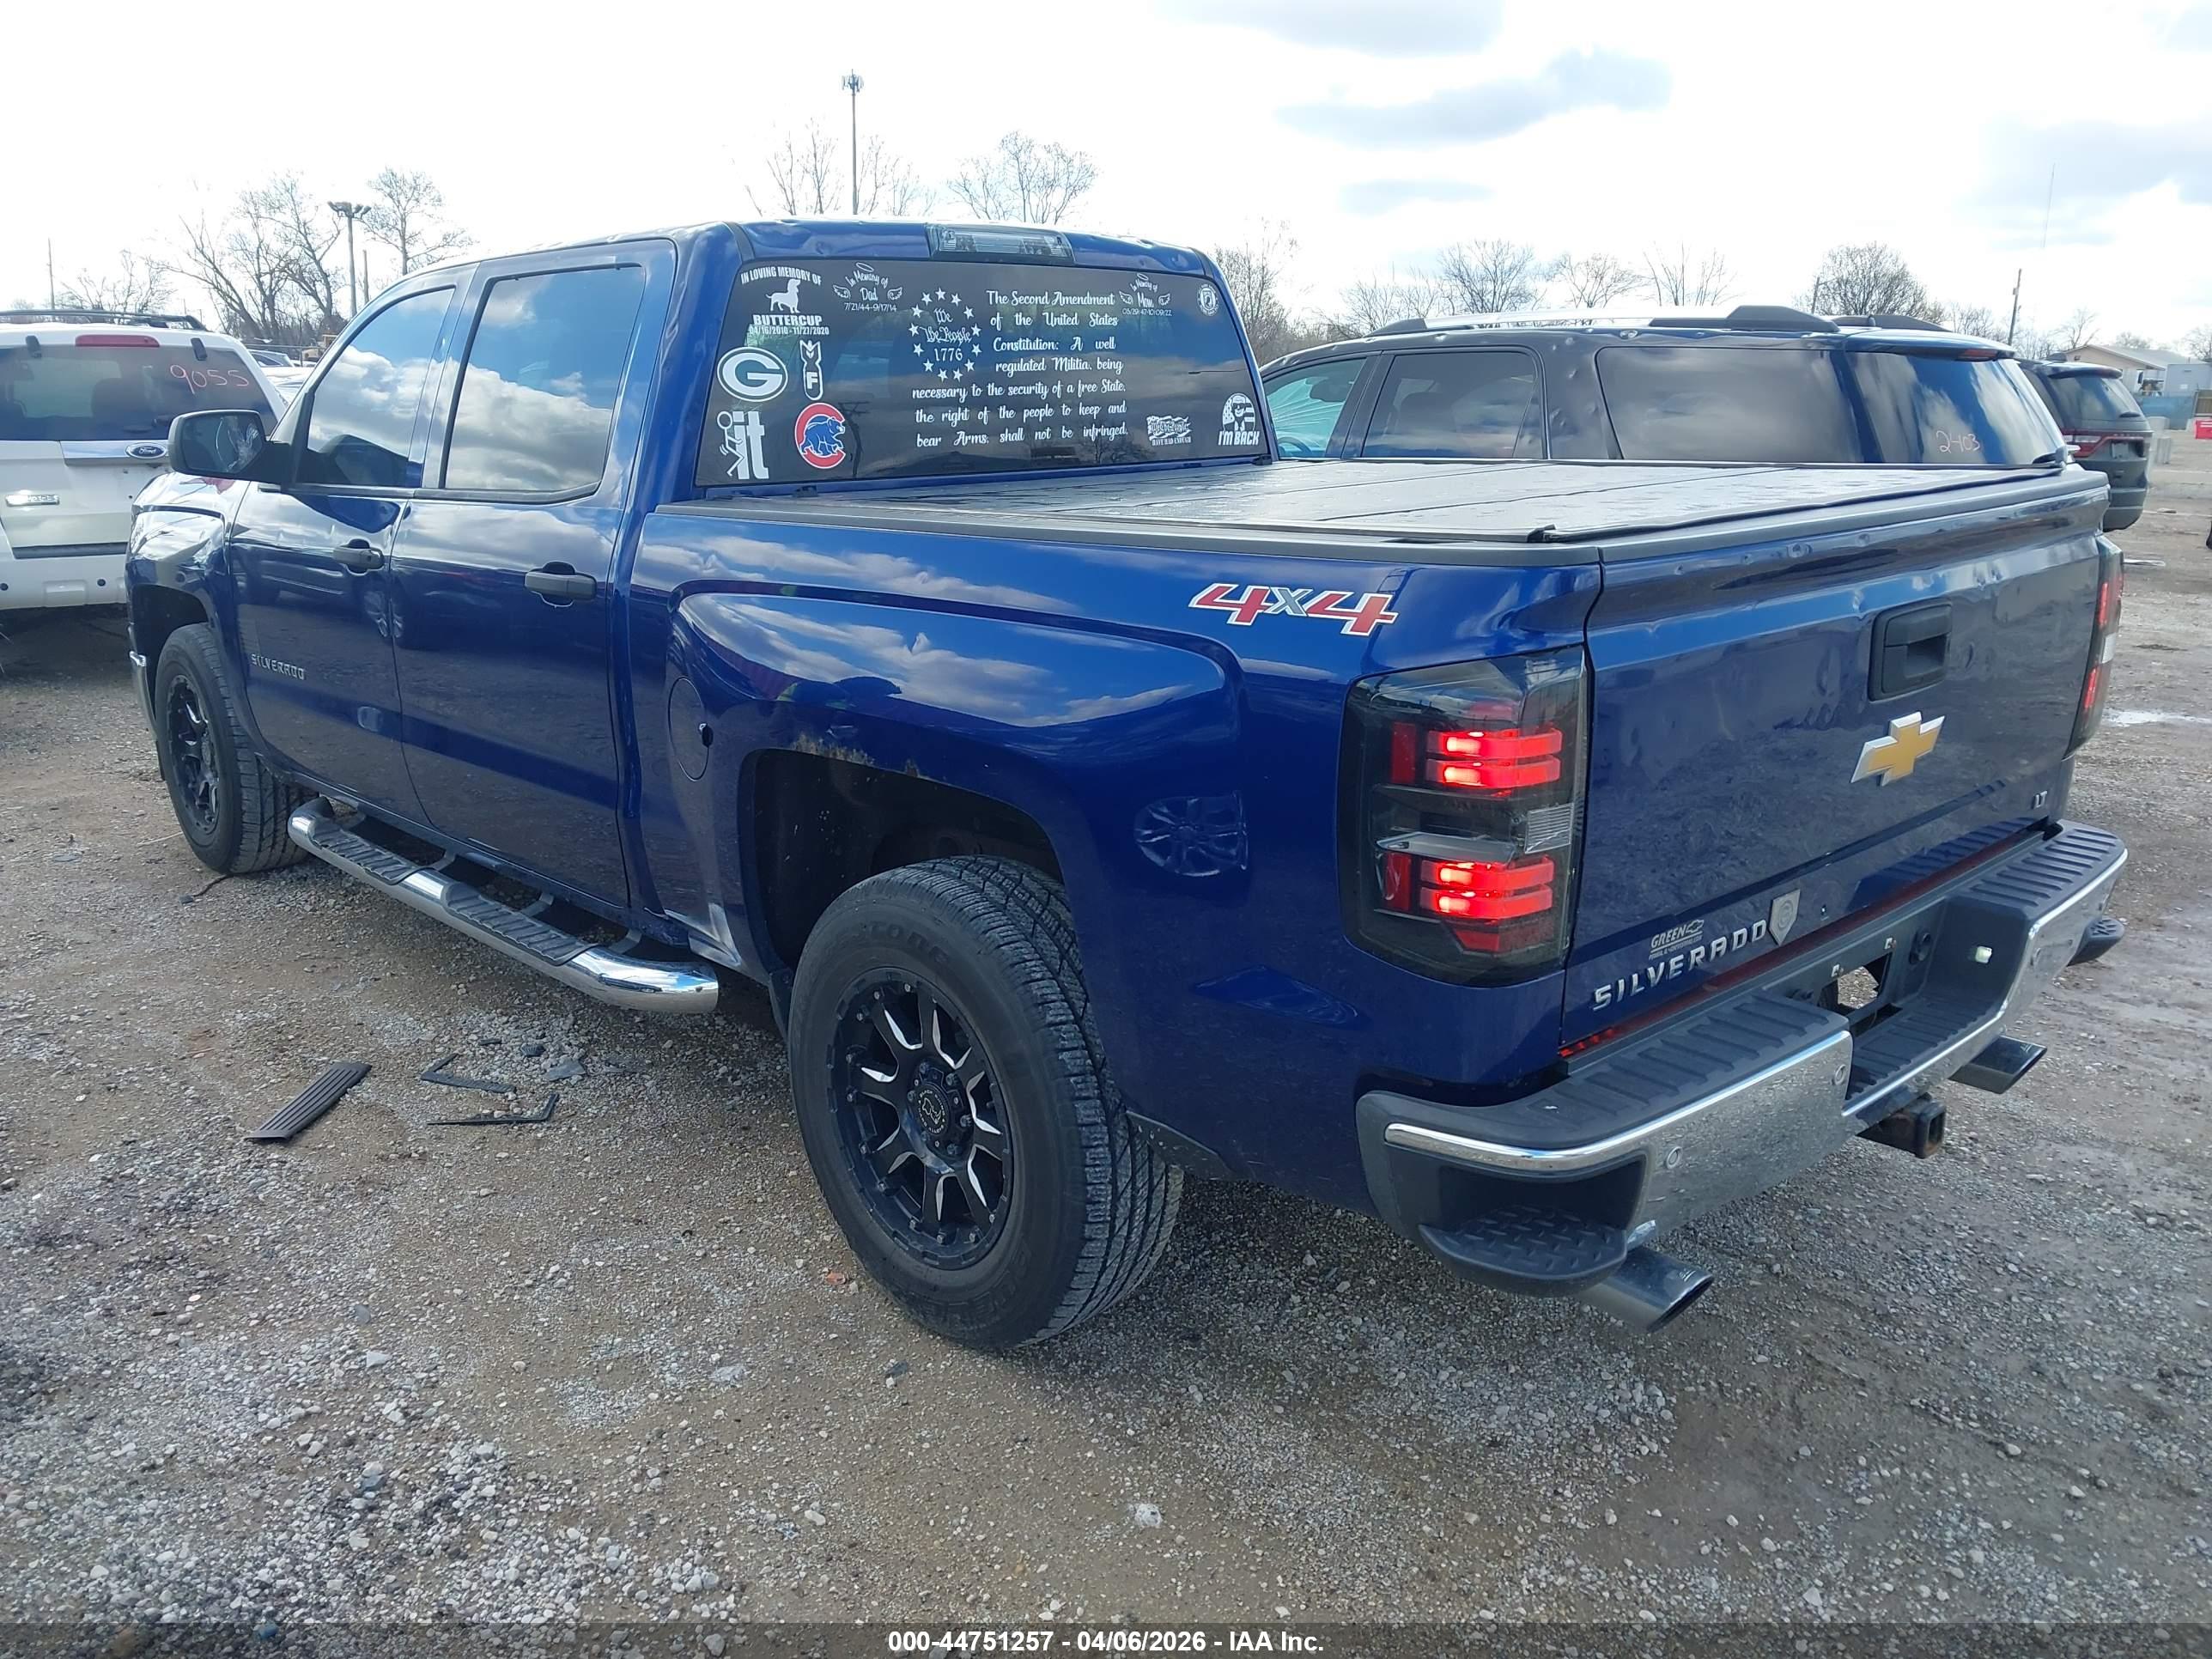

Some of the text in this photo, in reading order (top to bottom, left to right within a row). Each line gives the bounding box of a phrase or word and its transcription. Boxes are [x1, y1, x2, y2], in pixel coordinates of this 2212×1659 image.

[741, 266, 822, 286] IN LOVING MEMORY OF
[854, 270, 879, 285] Memory
[860, 288, 878, 301] Dad
[986, 290, 1115, 306] The Second Amendment
[753, 314, 823, 325] BUTTERCUP
[990, 312, 1119, 331] of the United States
[993, 336, 1116, 351] Constitution: A well
[934, 348, 963, 362] 1776
[721, 353, 783, 397] G
[995, 357, 1047, 378] regulated
[1097, 356, 1124, 375] being
[169, 364, 249, 395] 9055
[806, 372, 818, 389] F
[912, 387, 968, 403] necessary
[970, 383, 983, 396] to
[987, 382, 1005, 396] the
[1007, 381, 1049, 399] security
[1052, 380, 1064, 398] of
[1066, 384, 1075, 393] a
[1078, 380, 1098, 398] free
[915, 399, 1127, 428] the right of the people to keep and
[732, 410, 769, 480] it
[916, 433, 942, 447] bear
[1000, 428, 1024, 443] shall
[1035, 427, 1051, 440] not
[1061, 425, 1073, 439] be
[1218, 430, 1260, 446] I'M BACK
[1935, 430, 1982, 454] 2403
[251, 653, 305, 680] SILVERADO
[2036, 790, 2048, 807] LT
[1651, 924, 1687, 948] GREEN
[1592, 919, 1768, 1012] SILVERADO
